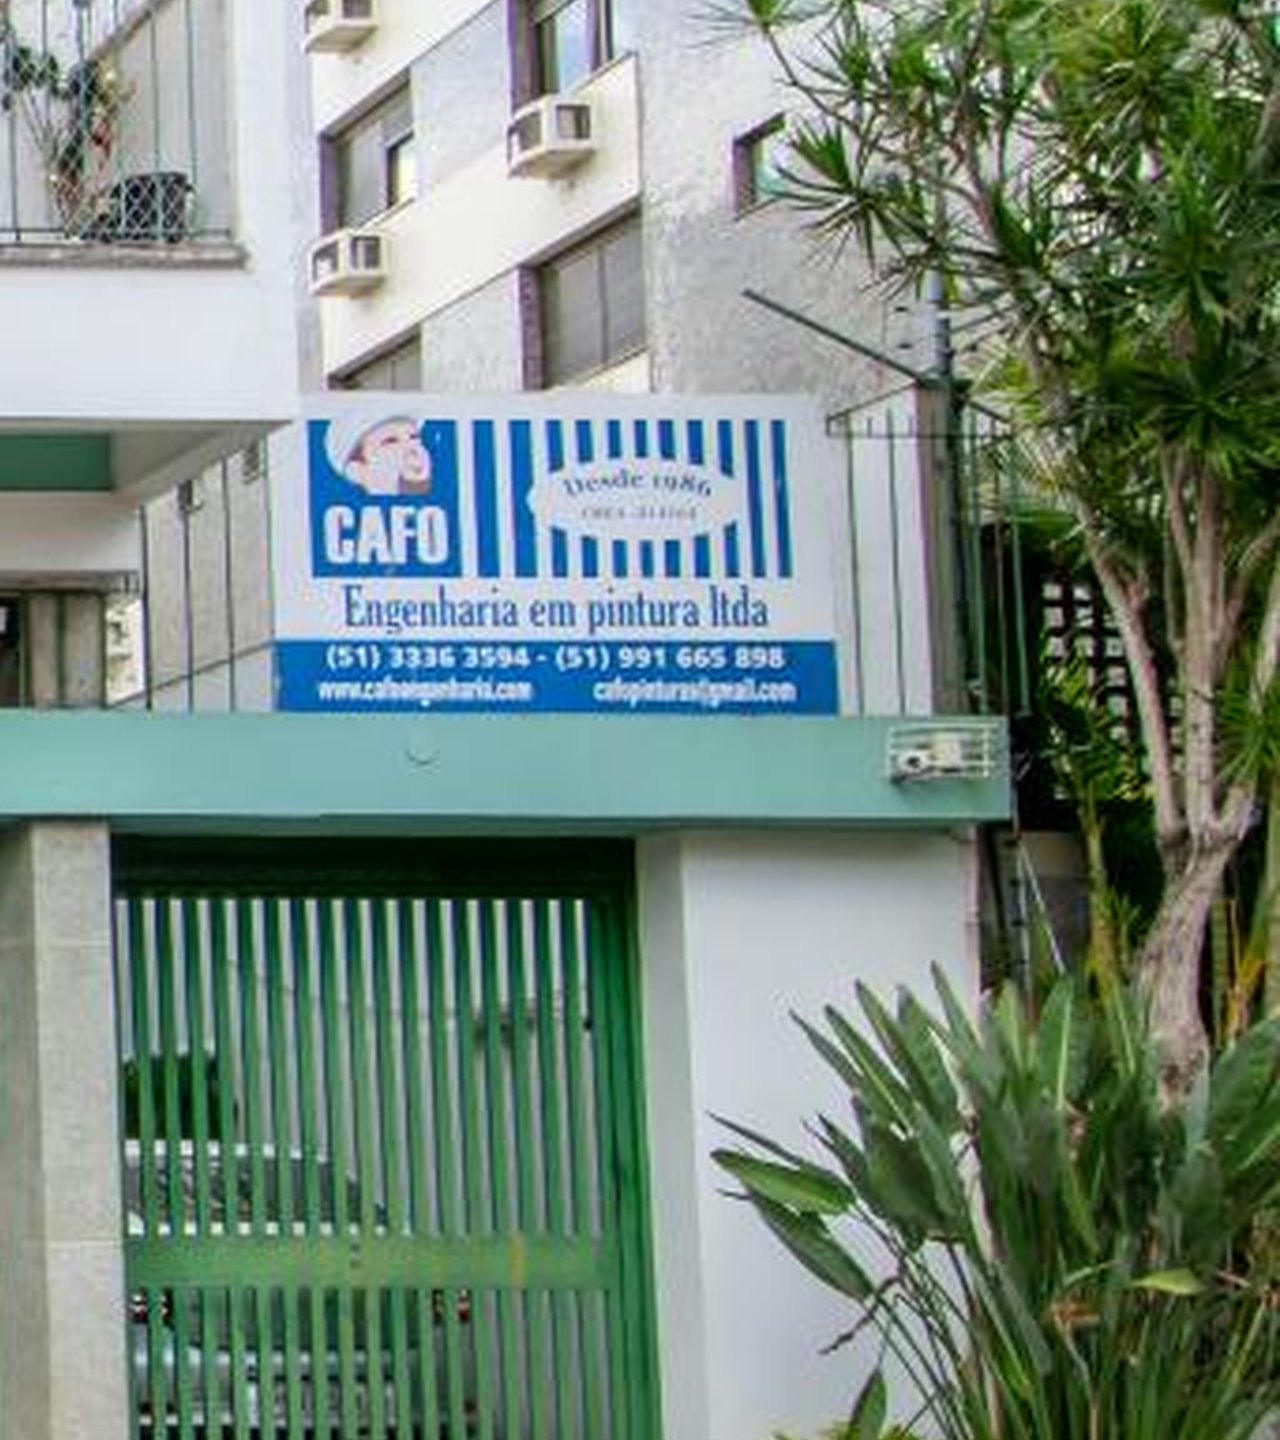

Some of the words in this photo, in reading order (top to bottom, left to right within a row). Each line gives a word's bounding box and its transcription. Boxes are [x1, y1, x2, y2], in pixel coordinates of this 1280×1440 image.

[563, 468, 644, 497] Desde
[652, 473, 712, 497] 1986
[323, 505, 449, 565] CAFO
[341, 584, 518, 634] Engenharia
[529, 594, 578, 627] em
[588, 587, 701, 634] pintura
[709, 584, 769, 627] ltda
[326, 644, 381, 671] (51)
[389, 645, 456, 669] 3336
[462, 645, 531, 669] 3594
[555, 644, 610, 671] (51)
[618, 645, 667, 669] 991
[676, 645, 728, 669] 665
[735, 645, 786, 669] 898
